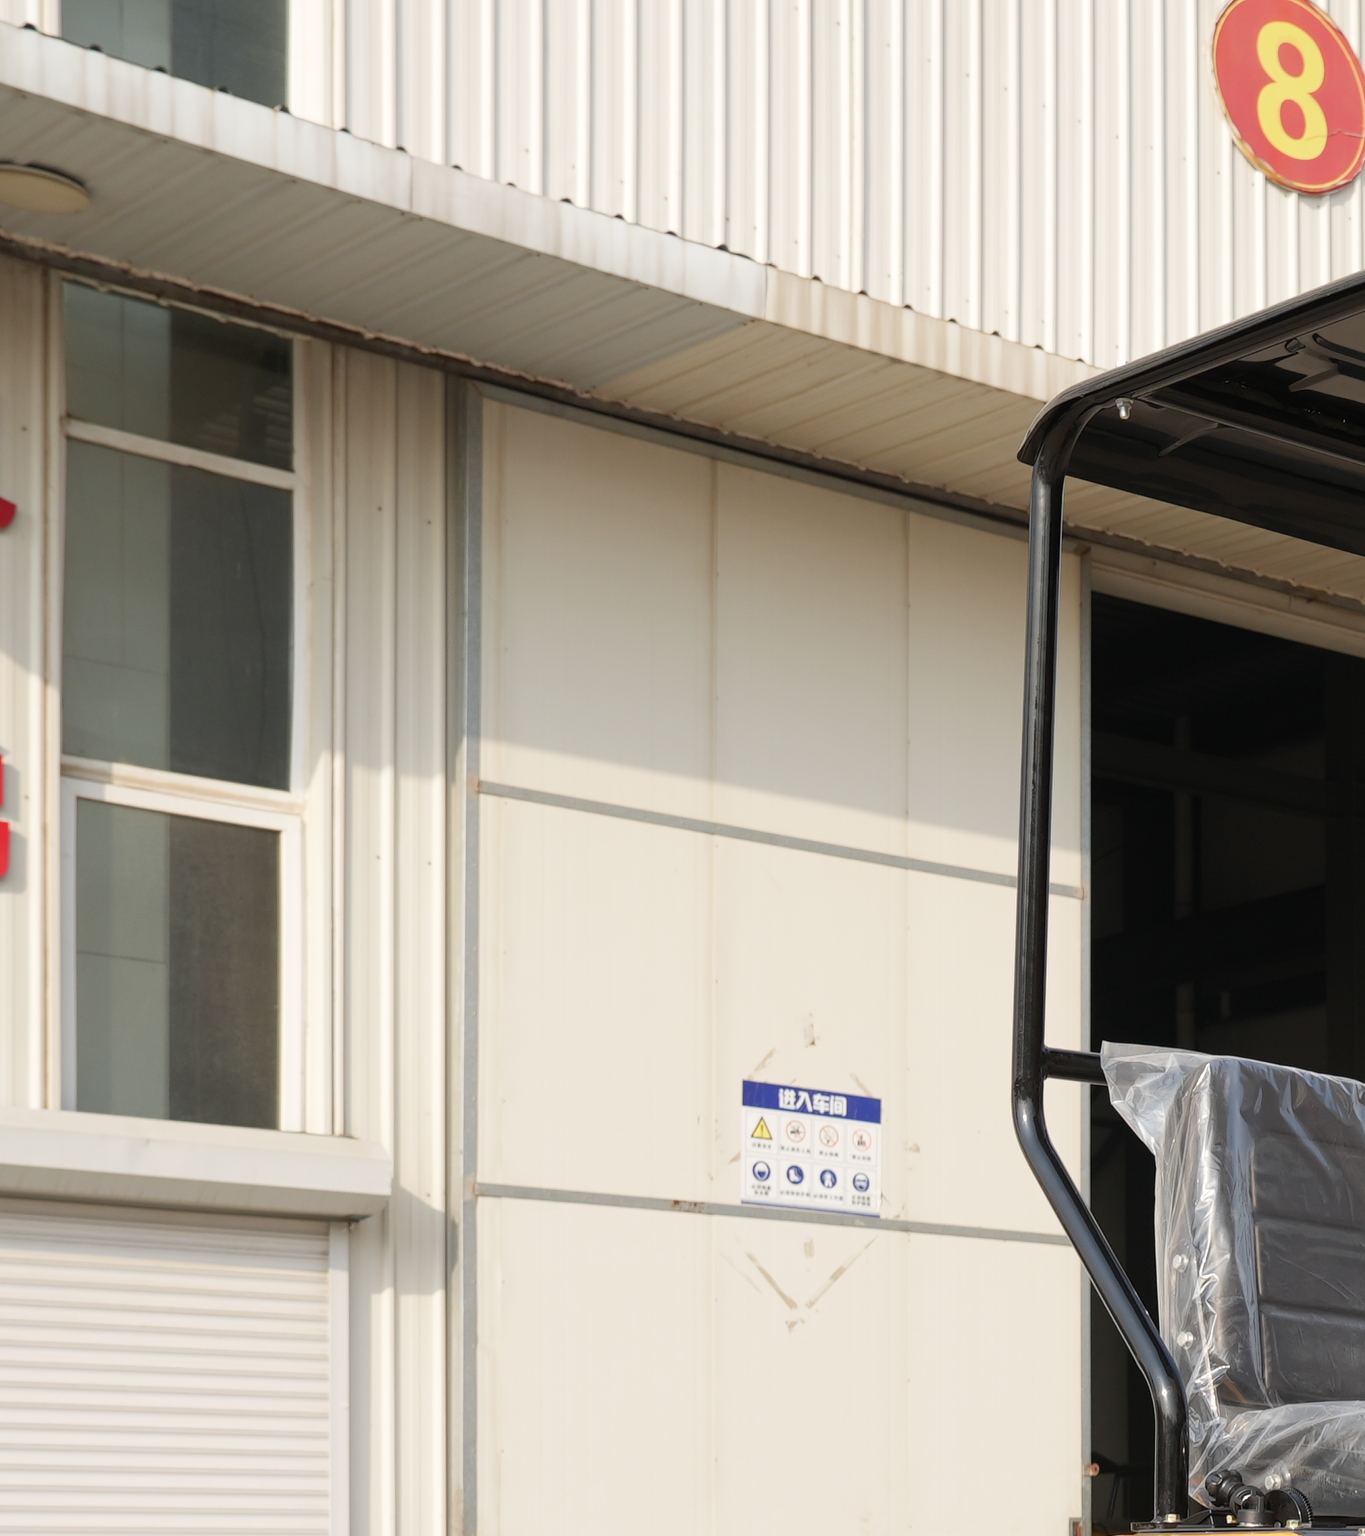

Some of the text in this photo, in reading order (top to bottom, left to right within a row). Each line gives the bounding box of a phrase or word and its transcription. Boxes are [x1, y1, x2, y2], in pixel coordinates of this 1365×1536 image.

[1257, 21, 1328, 160] 8
[778, 1088, 848, 1117] 进入车间
